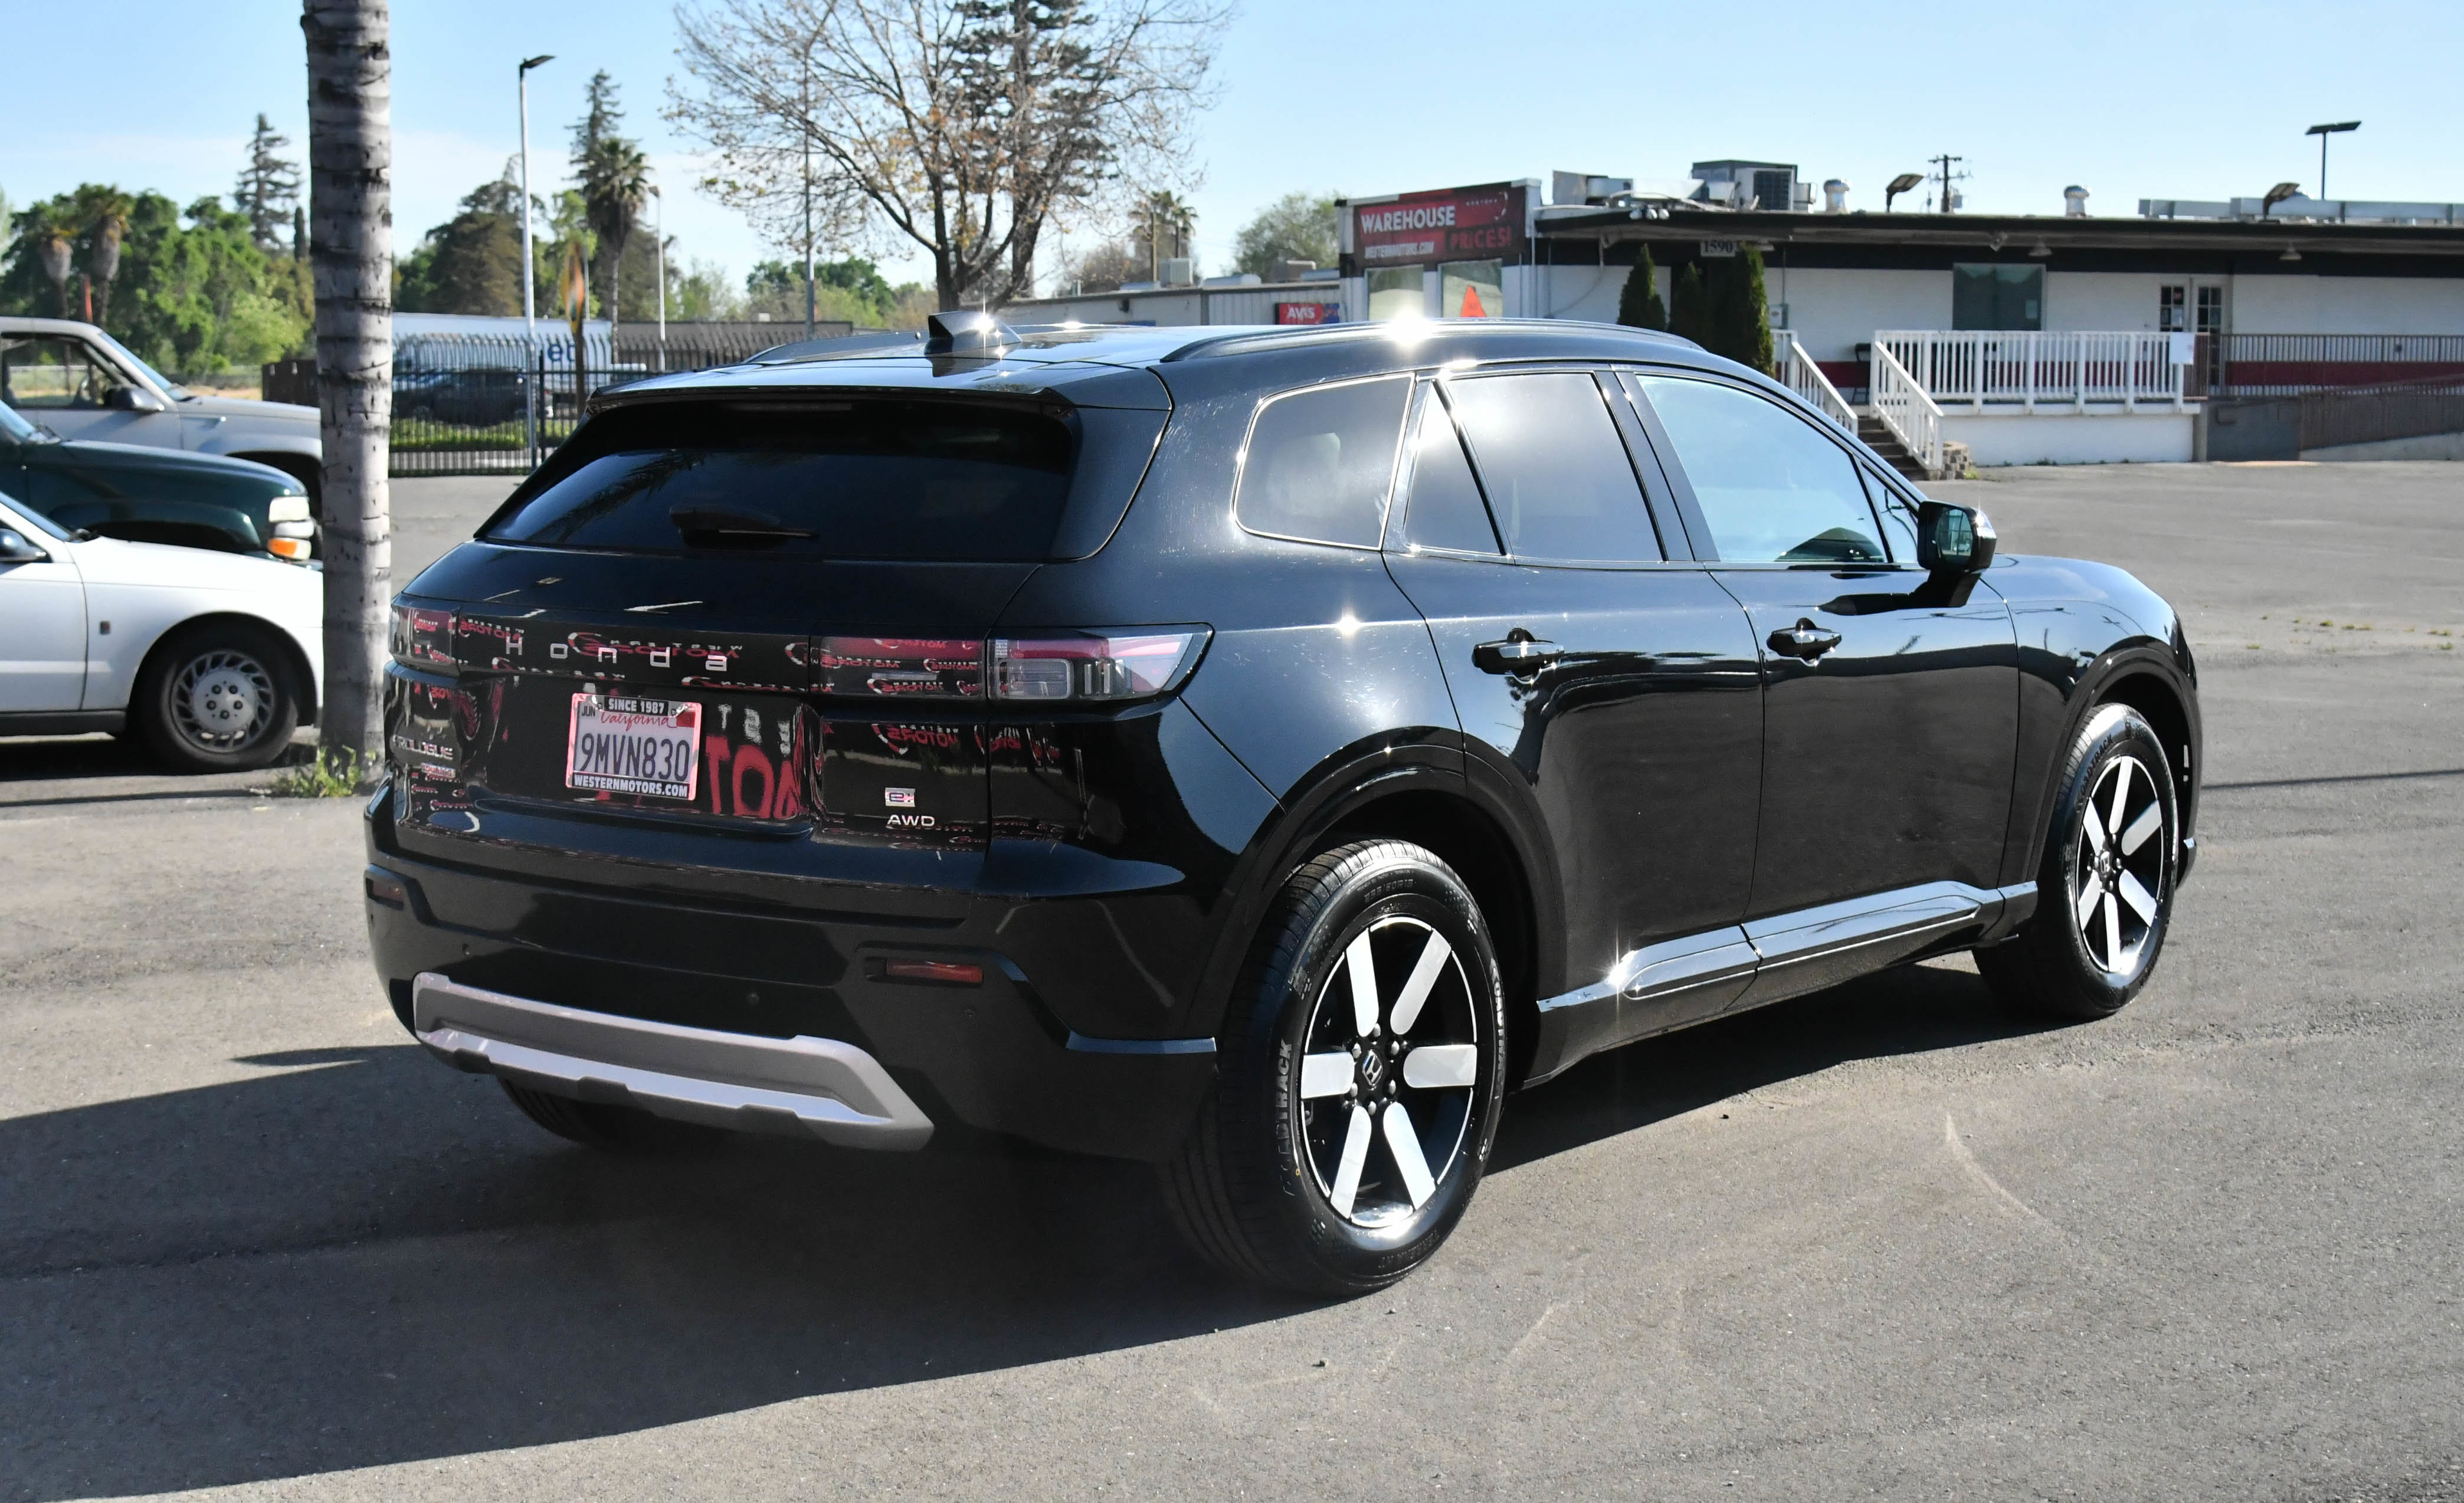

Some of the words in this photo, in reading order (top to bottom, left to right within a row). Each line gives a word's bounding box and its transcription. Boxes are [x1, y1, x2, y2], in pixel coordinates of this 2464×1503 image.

[1361, 205, 1456, 234] WAREHOUSE
[1451, 226, 1512, 249] PRICES!
[1704, 239, 1734, 254] 1590
[582, 705, 596, 717] JUN
[608, 698, 637, 712] SINCE
[640, 701, 664, 714] 1987
[580, 733, 690, 781] 9MVN830
[574, 774, 687, 797] WESTERNMOTORS.COM
[887, 815, 935, 826] AWD
